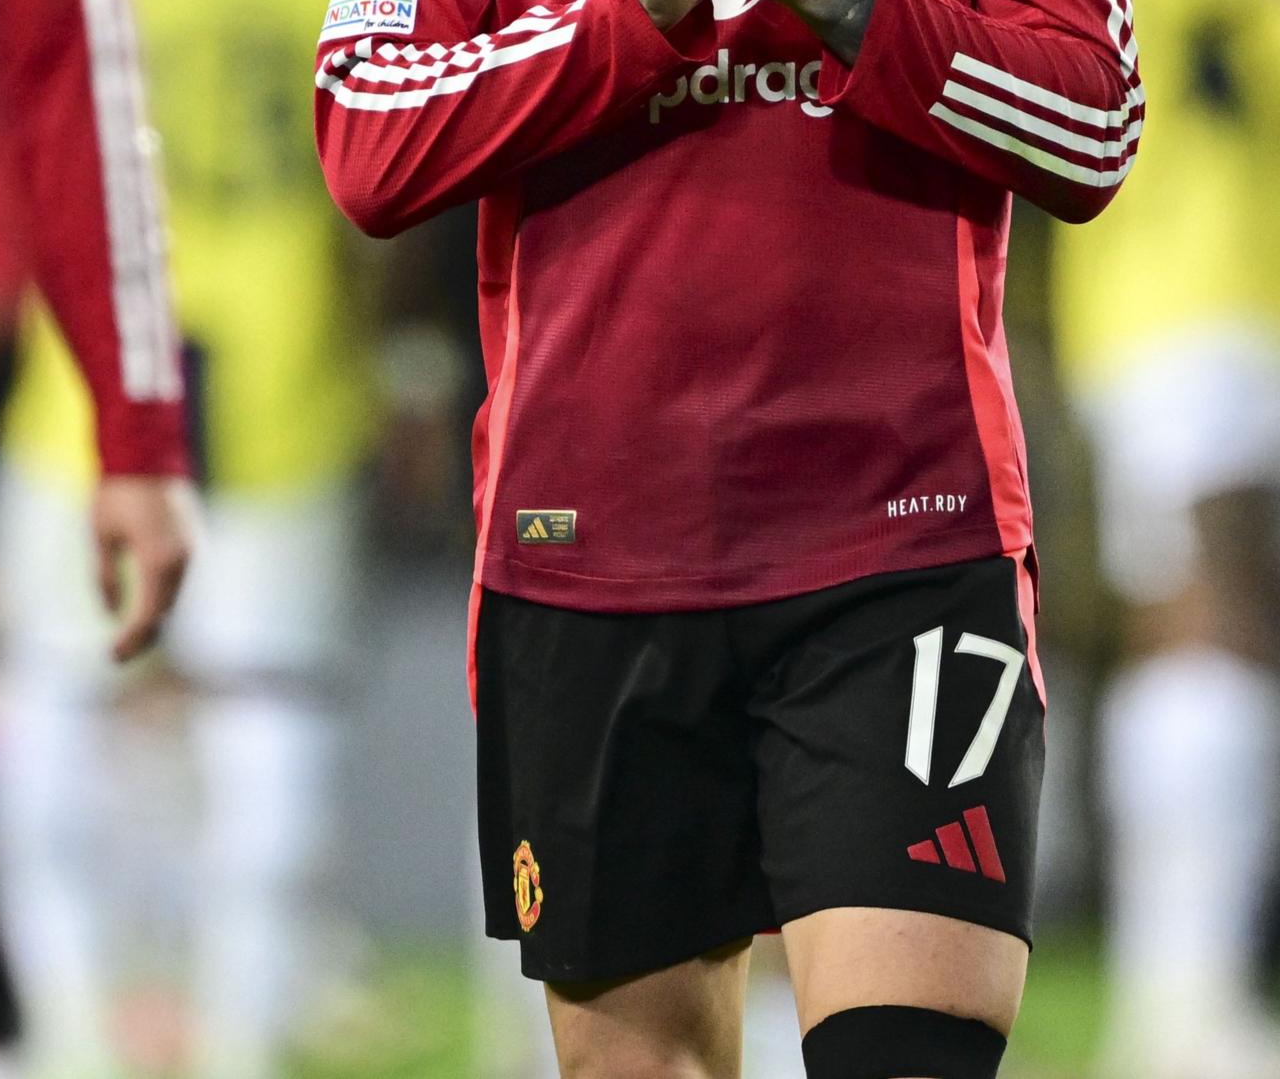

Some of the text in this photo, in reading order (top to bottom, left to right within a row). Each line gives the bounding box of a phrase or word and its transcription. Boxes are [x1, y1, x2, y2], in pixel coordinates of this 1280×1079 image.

[326, 0, 412, 22] NDATiON
[377, 19, 410, 30] children
[649, 48, 834, 124] pdrag
[887, 494, 967, 518] HEAT.RDY
[905, 626, 1025, 788] 17
